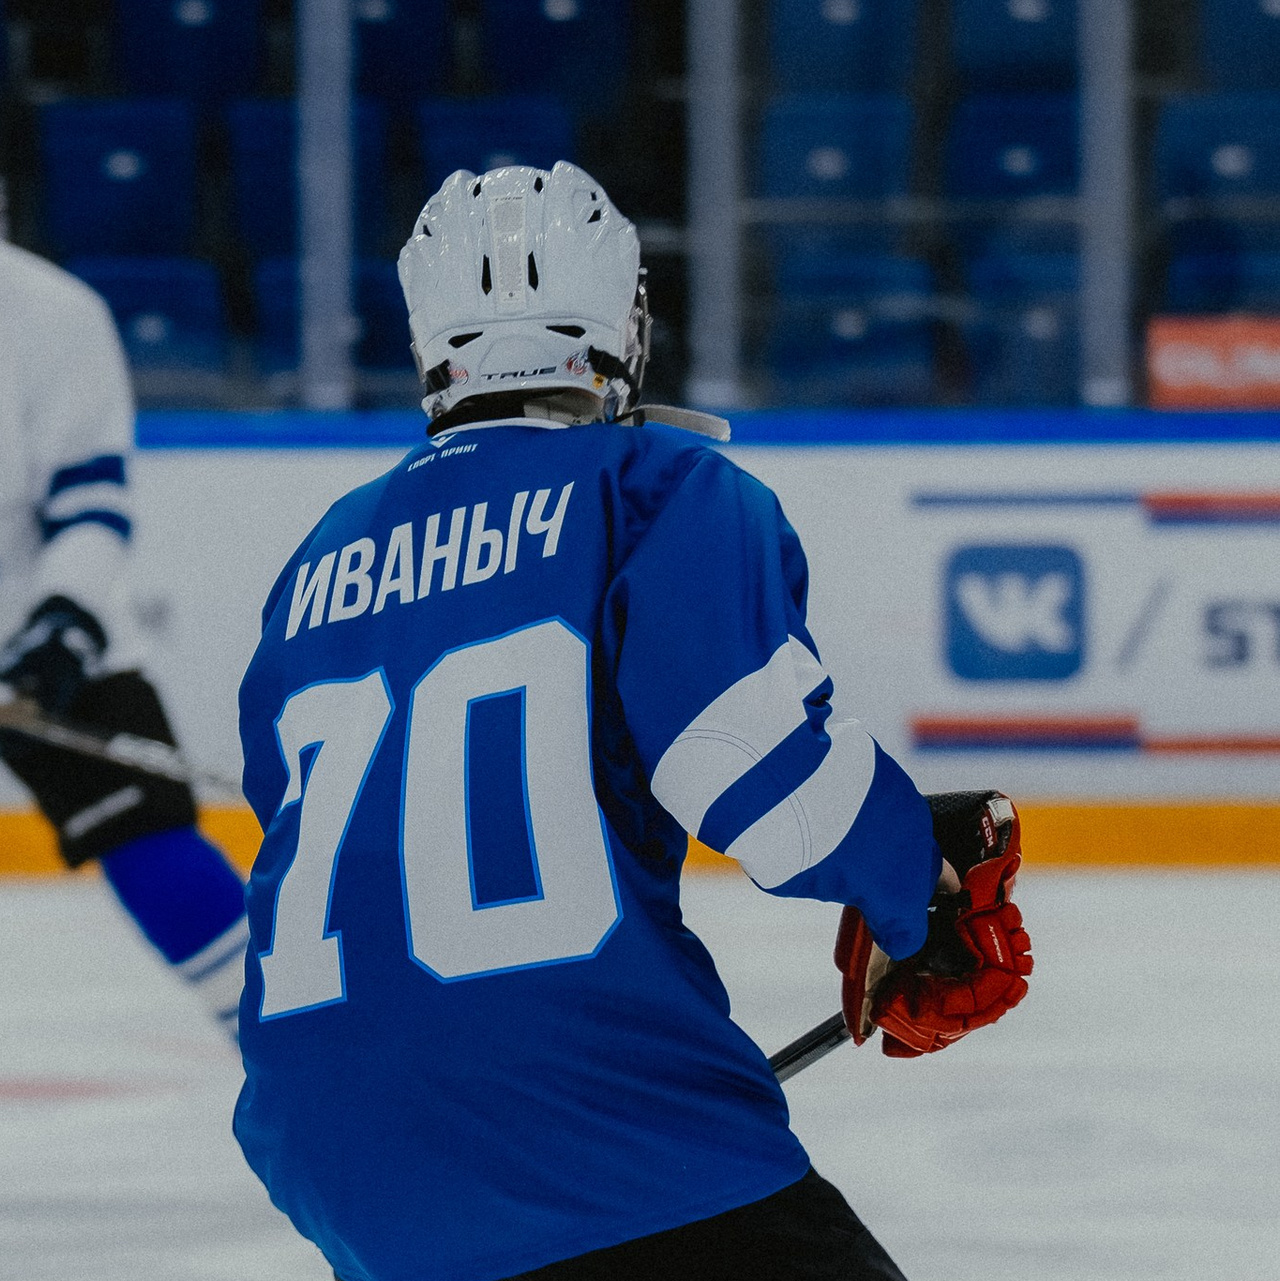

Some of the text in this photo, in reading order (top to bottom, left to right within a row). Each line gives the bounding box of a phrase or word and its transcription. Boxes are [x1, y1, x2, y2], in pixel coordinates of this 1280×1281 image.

[480, 366, 557, 381] TRUE
[285, 481, 575, 641] ИВАНЫЧ
[259, 616, 623, 1021] 70
[982, 816, 995, 848] CCM
